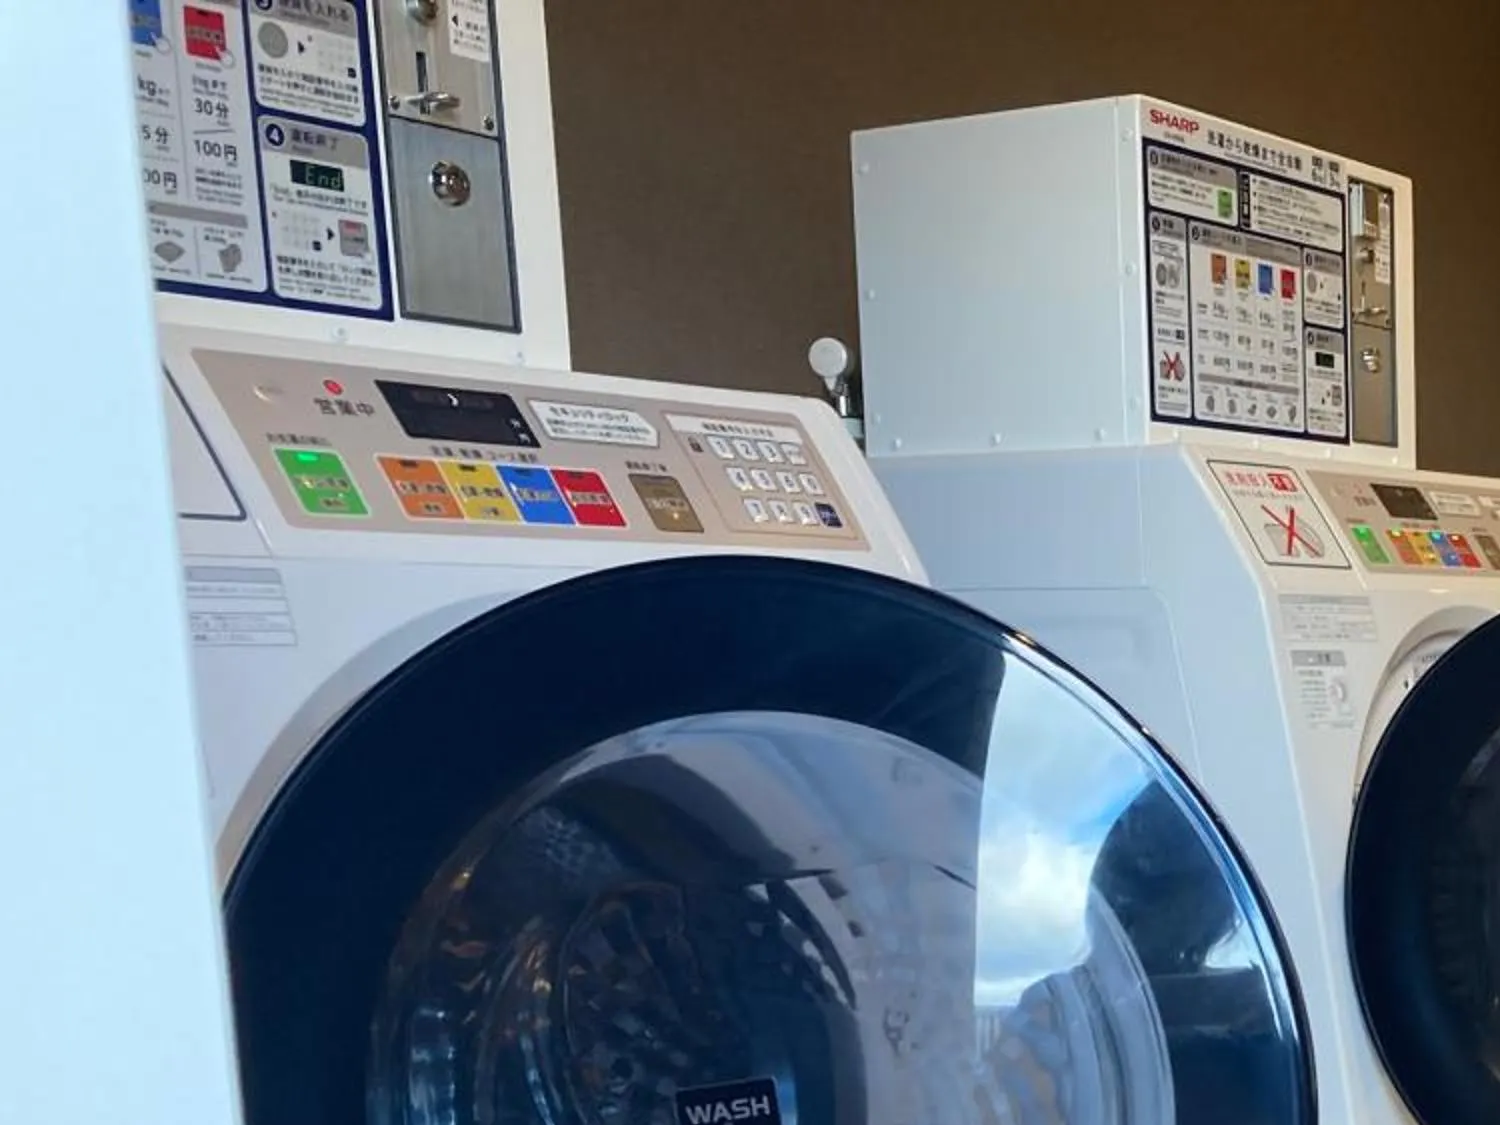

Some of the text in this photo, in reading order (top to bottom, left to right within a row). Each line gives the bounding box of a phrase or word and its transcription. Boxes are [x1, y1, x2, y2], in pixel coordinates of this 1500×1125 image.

[194, 98, 229, 119] 30分
[1150, 109, 1199, 133] SHARP
[141, 125, 168, 144] 5分
[194, 140, 237, 161] 100円
[306, 165, 342, 189] End
[313, 398, 375, 416] 営業中
[685, 1095, 771, 1125] WASH
